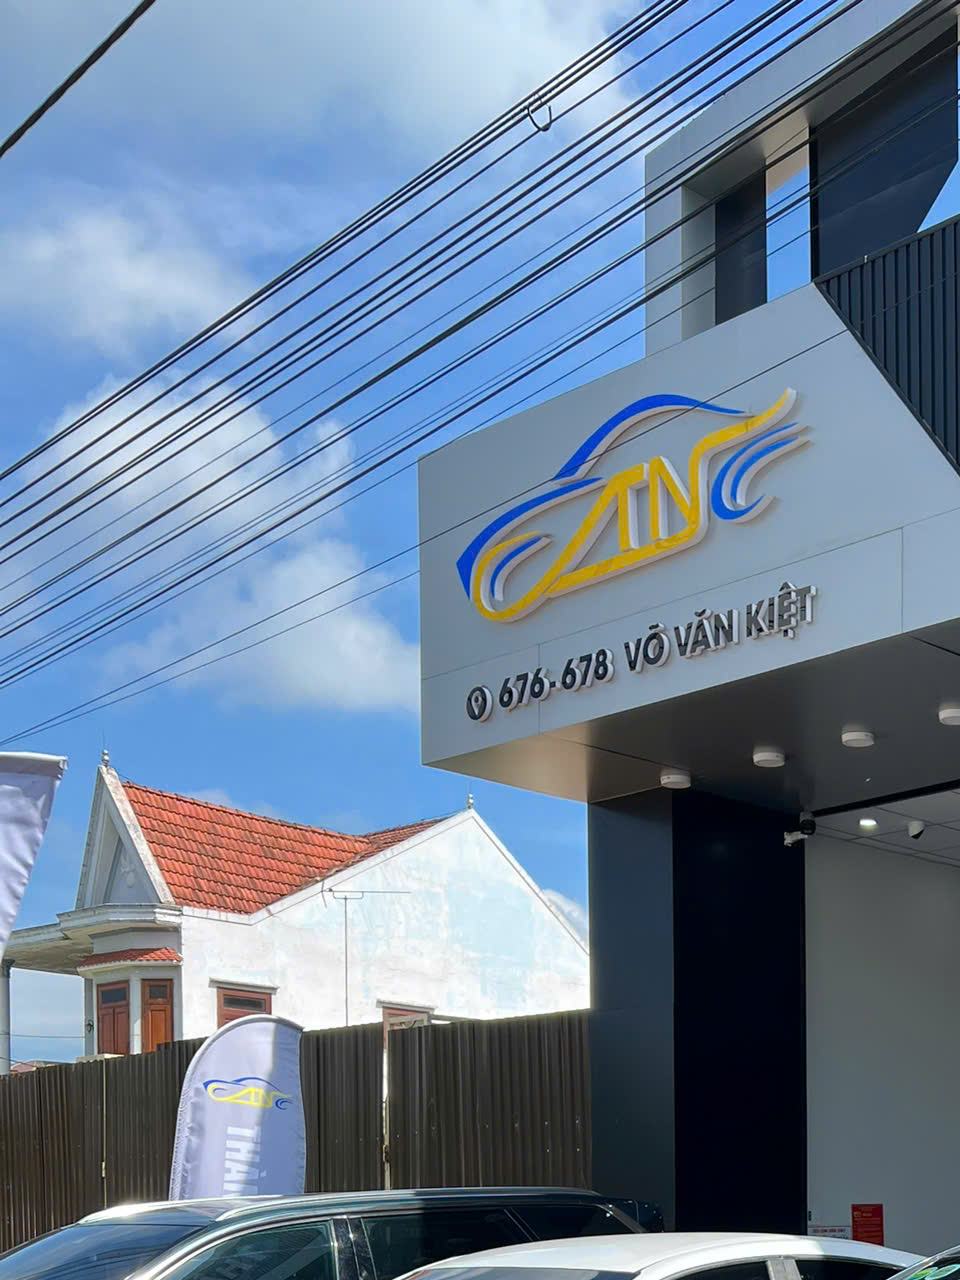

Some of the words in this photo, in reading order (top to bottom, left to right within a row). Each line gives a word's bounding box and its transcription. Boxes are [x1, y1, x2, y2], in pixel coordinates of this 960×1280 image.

[498, 648, 615, 711] 676-678
[624, 622, 670, 672] VÕ
[674, 608, 739, 658] VĂN
[746, 581, 817, 639] KIỆT
